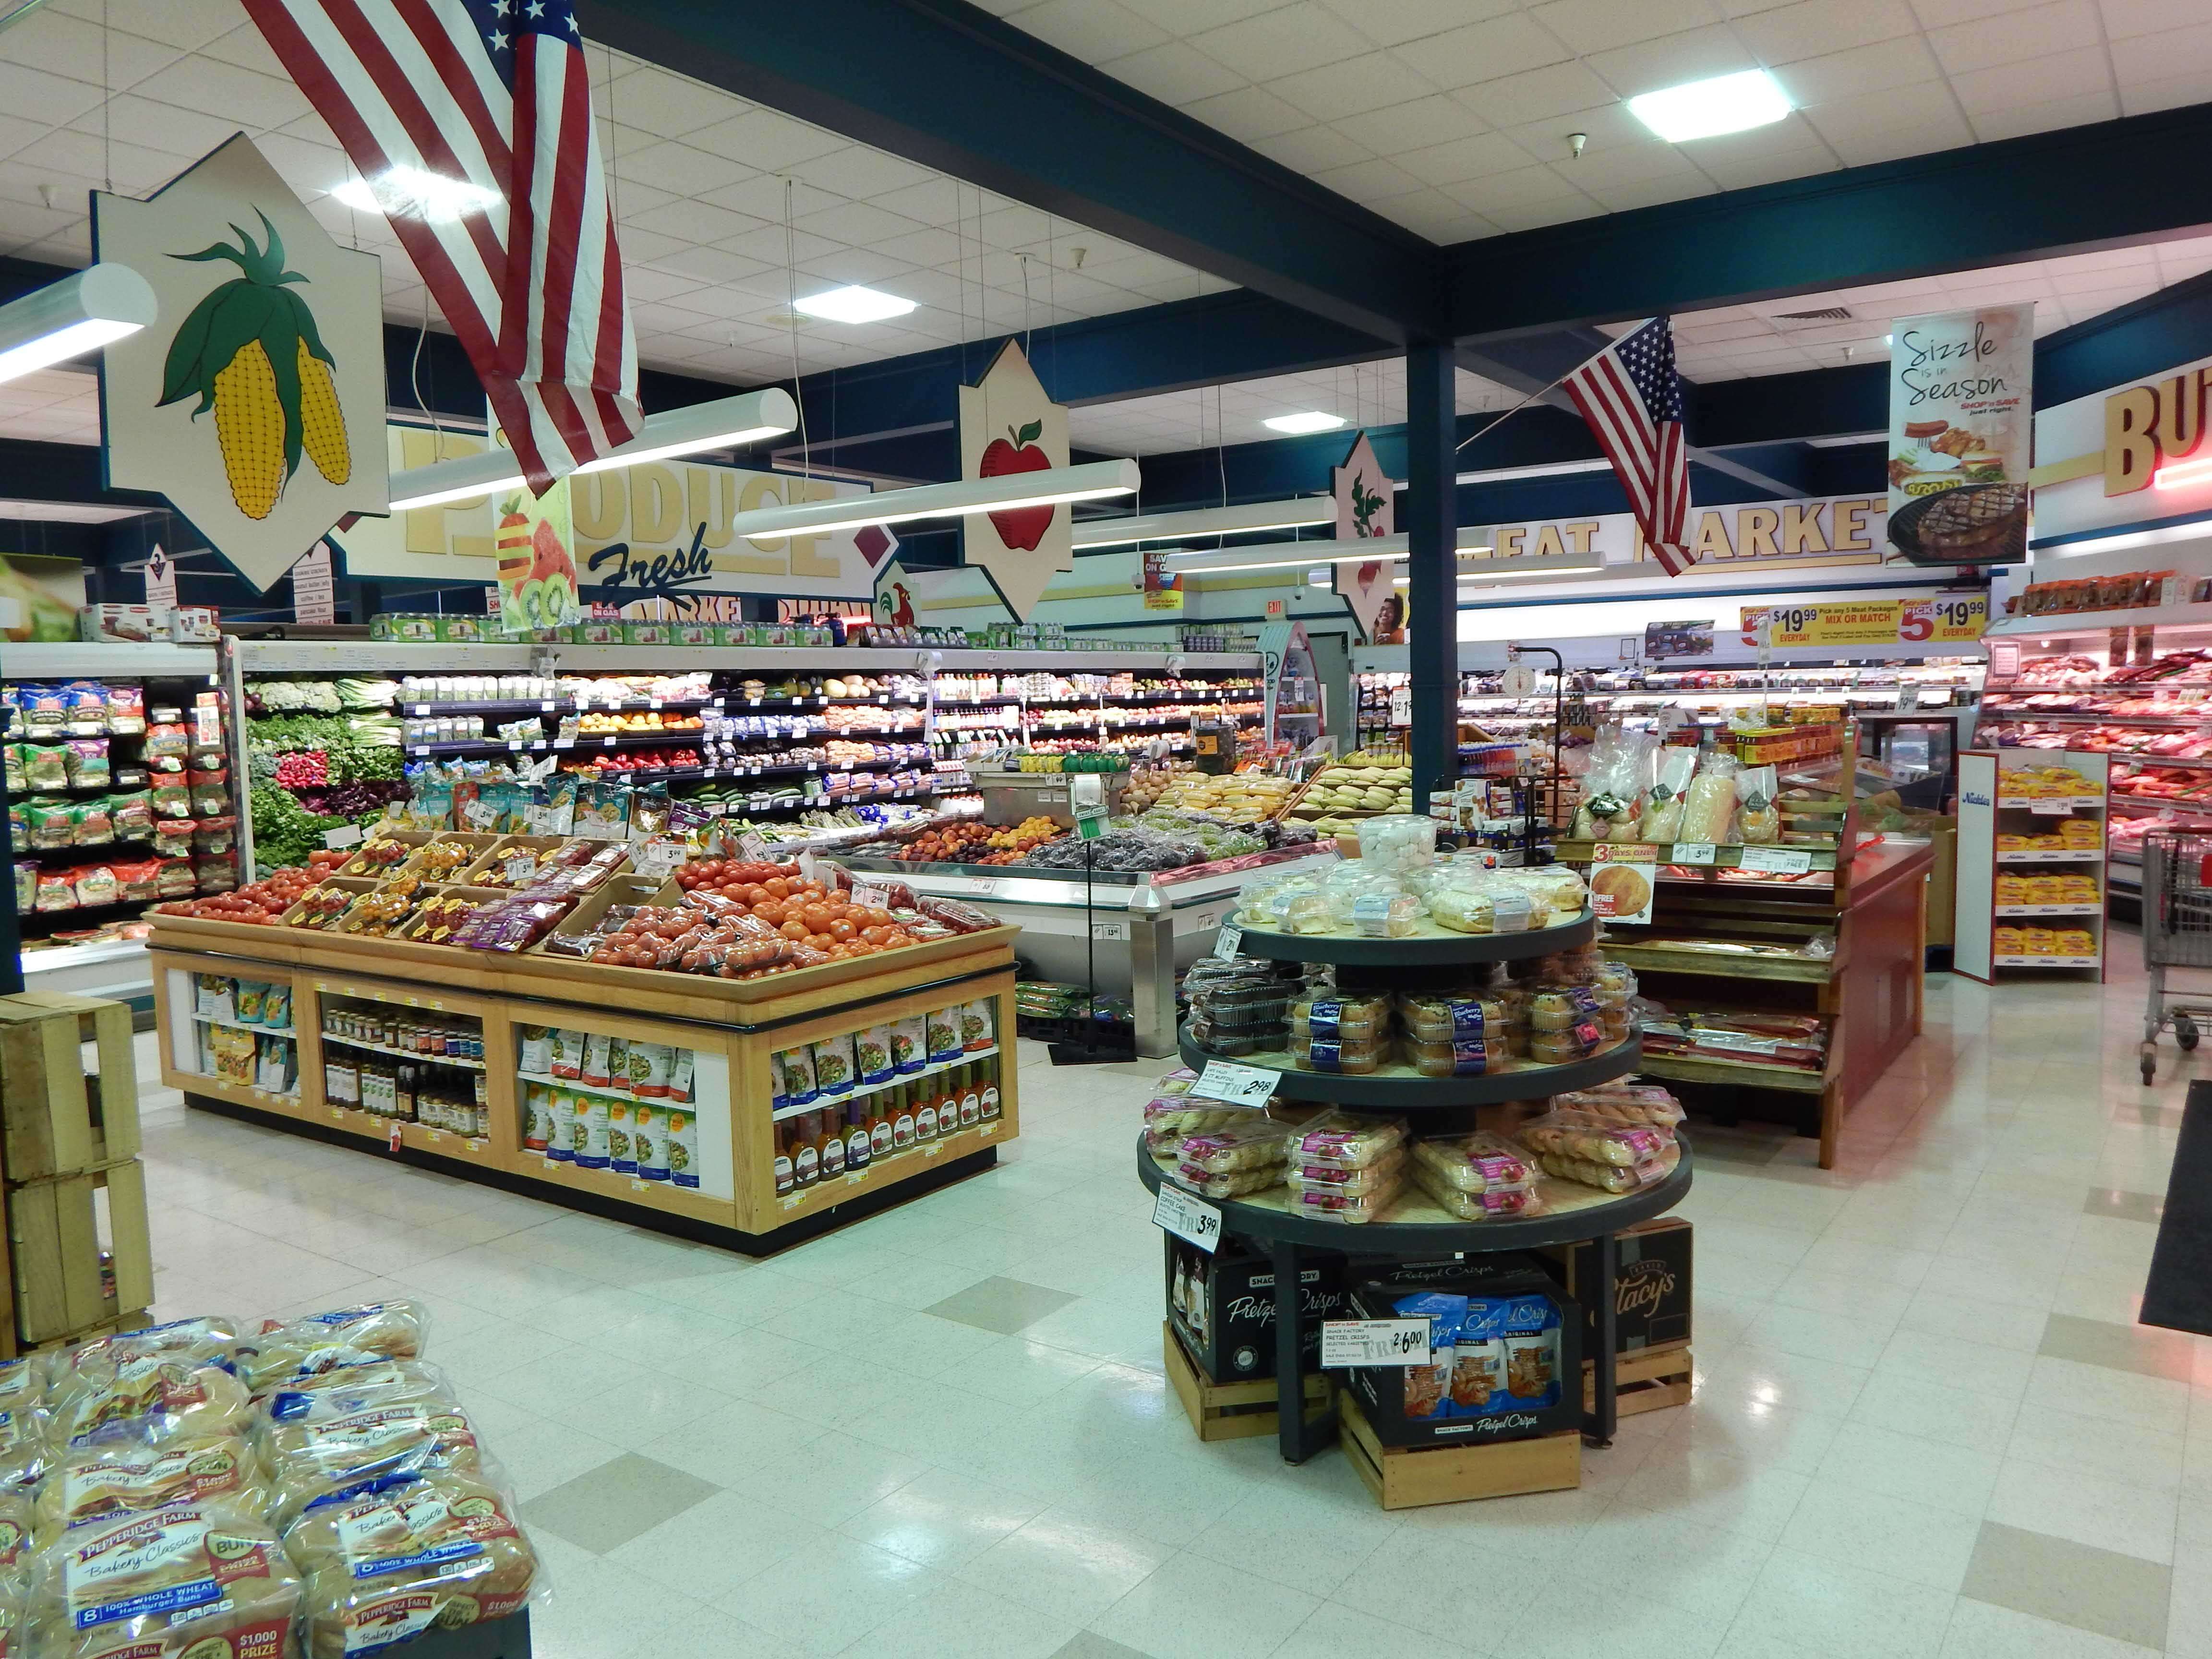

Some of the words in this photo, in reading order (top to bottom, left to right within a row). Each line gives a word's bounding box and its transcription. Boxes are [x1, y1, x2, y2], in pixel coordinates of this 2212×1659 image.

[1902, 321, 1997, 367] Sizzle
[1901, 367, 2008, 406] Season
[2104, 367, 2212, 498] BU
[401, 430, 842, 578] PODUCE
[1634, 498, 1888, 562] ARKE
[588, 522, 711, 591] Fresh
[1150, 554, 1167, 563] SAV
[1268, 601, 1281, 613] EXIT
[1826, 615, 1841, 624] MIX
[1844, 614, 1856, 623] OR
[1860, 613, 1890, 623] MATCH
[1900, 614, 1934, 641] 5
[1779, 633, 1810, 642] EVERYDAY
[1943, 627, 1977, 637] EVERYDAY
[1594, 845, 1608, 862] 3
[1454, 1008, 1481, 1017] Blueberry
[1160, 1195, 1176, 1207] COFFEE
[1252, 1276, 1275, 1285] SNAC
[1615, 1273, 1676, 1318] tacy's
[1227, 1296, 1276, 1327] Pretze
[383, 1410, 410, 1420] FARM
[1477, 1418, 1507, 1434] Pretzel
[1509, 1413, 1538, 1429] Crisps
[356, 1515, 396, 1533] Baker
[86, 1519, 159, 1558] PEPPERIDGE
[162, 1512, 196, 1528] FARM
[85, 1557, 142, 1577] Bakery
[145, 1532, 202, 1562] Classics
[84, 1609, 97, 1623] 8
[105, 1600, 129, 1612] 100%
[133, 1591, 174, 1607] WHOLE
[176, 1582, 215, 1595] WHEAT
[119, 1599, 174, 1615] Hamburger
[178, 1592, 201, 1604] Buns
[361, 1600, 406, 1622] PEPPERIDGE
[408, 1598, 428, 1607] FARM
[240, 1631, 277, 1646] $1,000
[360, 1630, 393, 1644] Bakery
[133, 1645, 157, 1658] FARM
[240, 1643, 277, 1659] PRIZE
